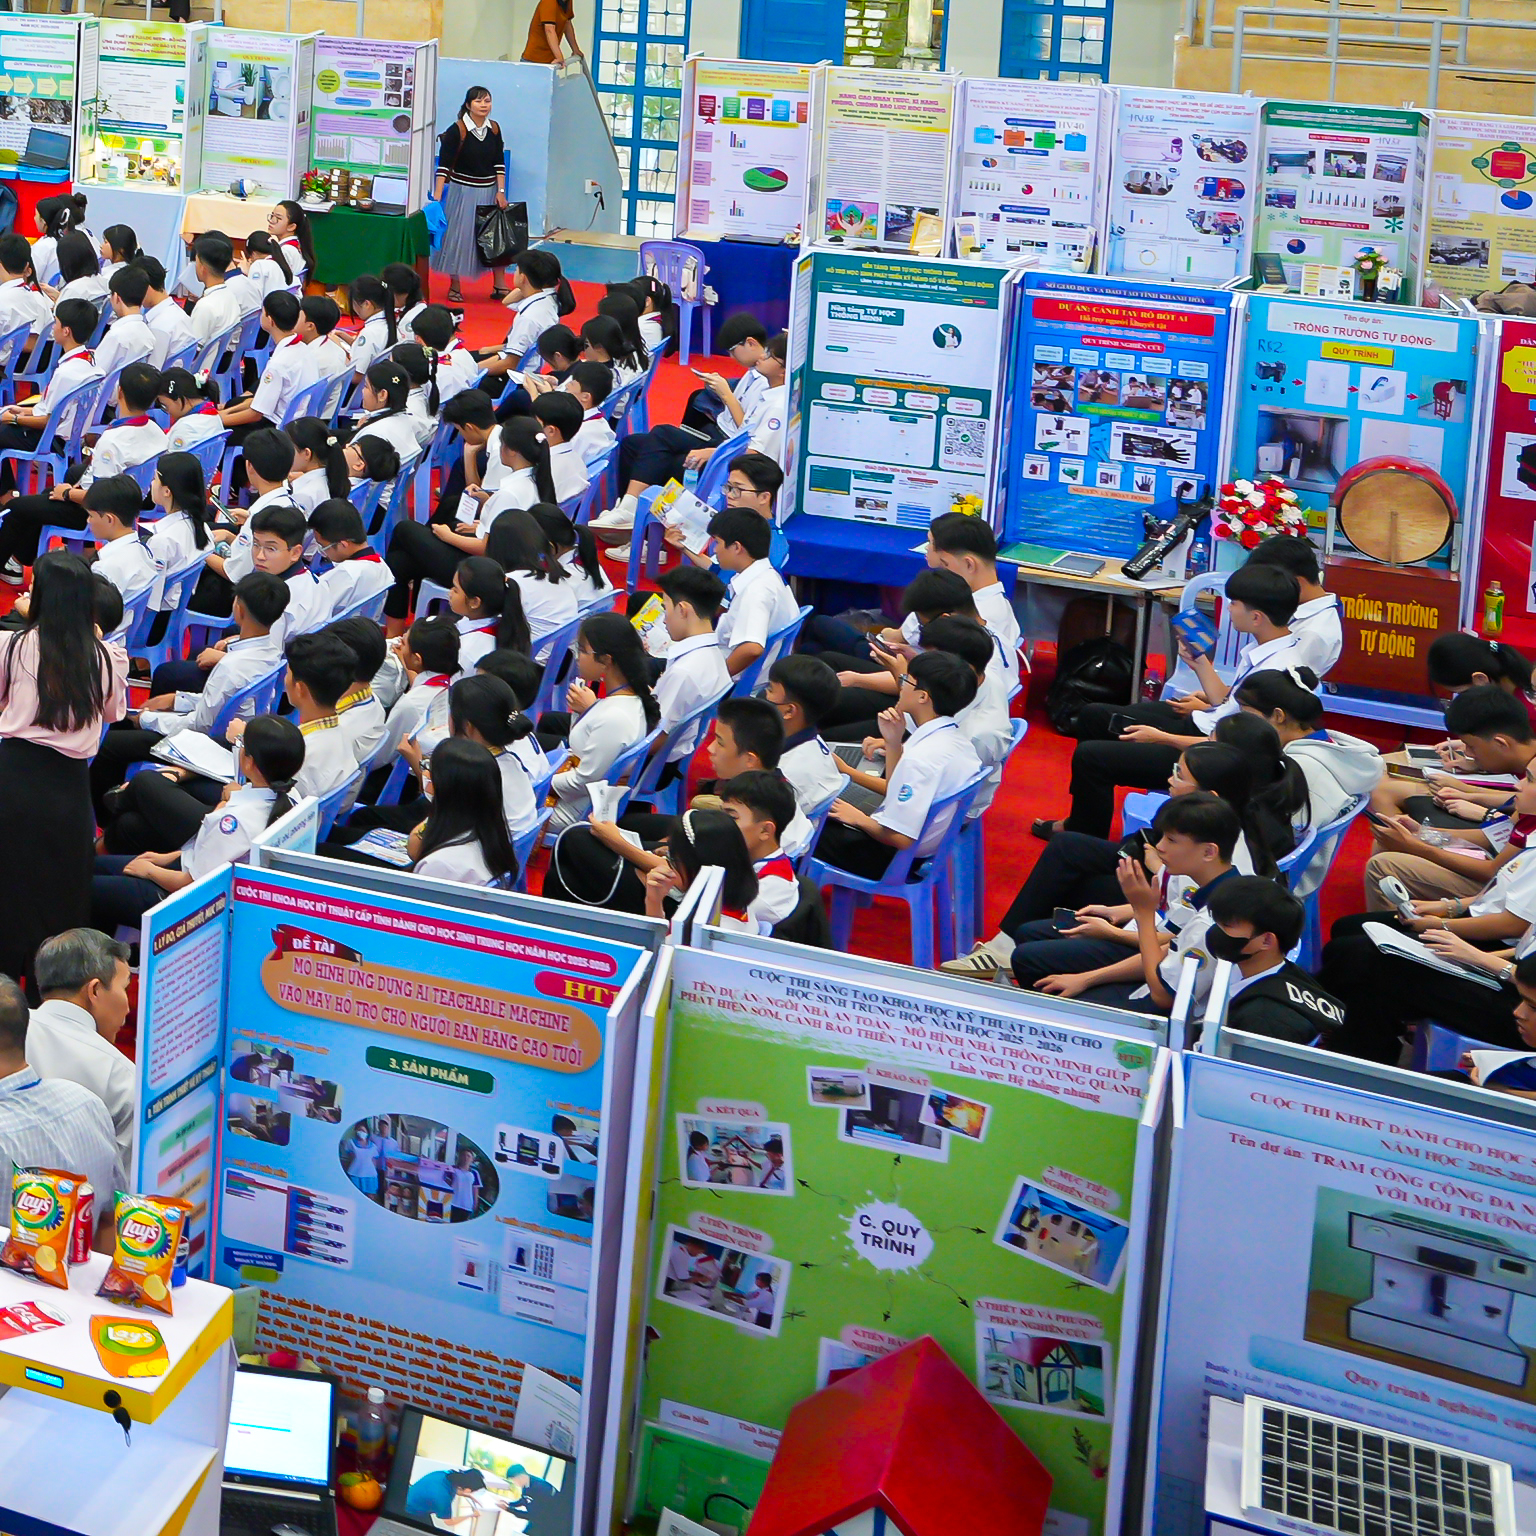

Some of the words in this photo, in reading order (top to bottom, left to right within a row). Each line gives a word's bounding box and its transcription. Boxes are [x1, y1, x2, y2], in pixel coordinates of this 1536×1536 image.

[1332, 346, 1351, 356] QUY
[1353, 348, 1379, 359] TRÌNH
[1340, 593, 1383, 621] TRỐNG
[1387, 600, 1438, 629] TRƯỜNG
[1360, 630, 1378, 656] TỰ
[1379, 630, 1415, 658] ĐỘNG
[236, 885, 258, 899] CUỘC
[259, 889, 271, 902] THI
[272, 892, 296, 907] KHOA
[297, 898, 315, 912] HỌC
[418, 923, 436, 936] CHO
[437, 927, 455, 940] HỌC
[456, 931, 475, 944] SINH
[477, 935, 505, 951] TRUNG
[506, 942, 524, 955] HỌC
[547, 949, 566, 963] HỌC
[292, 934, 311, 950] ĐỀ
[313, 936, 336, 954] TÀI
[416, 983, 428, 1000] AI
[433, 987, 506, 1019] TEACHABLE
[509, 1005, 570, 1033] MACHINE
[749, 968, 786, 985] CUỘC
[789, 976, 811, 989] THI
[852, 989, 878, 1004] TẠO
[882, 993, 919, 1012] KHOA
[924, 1003, 954, 1018] HỌC
[1071, 1035, 1103, 1050] CHO
[389, 1056, 400, 1069] 3.
[402, 1058, 427, 1078] SẢN
[429, 1063, 469, 1087] PHẨM
[1302, 1103, 1331, 1119] THI
[1335, 1111, 1384, 1132] KHKT
[1443, 1136, 1482, 1154] CHO
[1487, 1146, 1527, 1164] HỌC
[859, 1214, 877, 1230] C.
[881, 1219, 921, 1239] QUY
